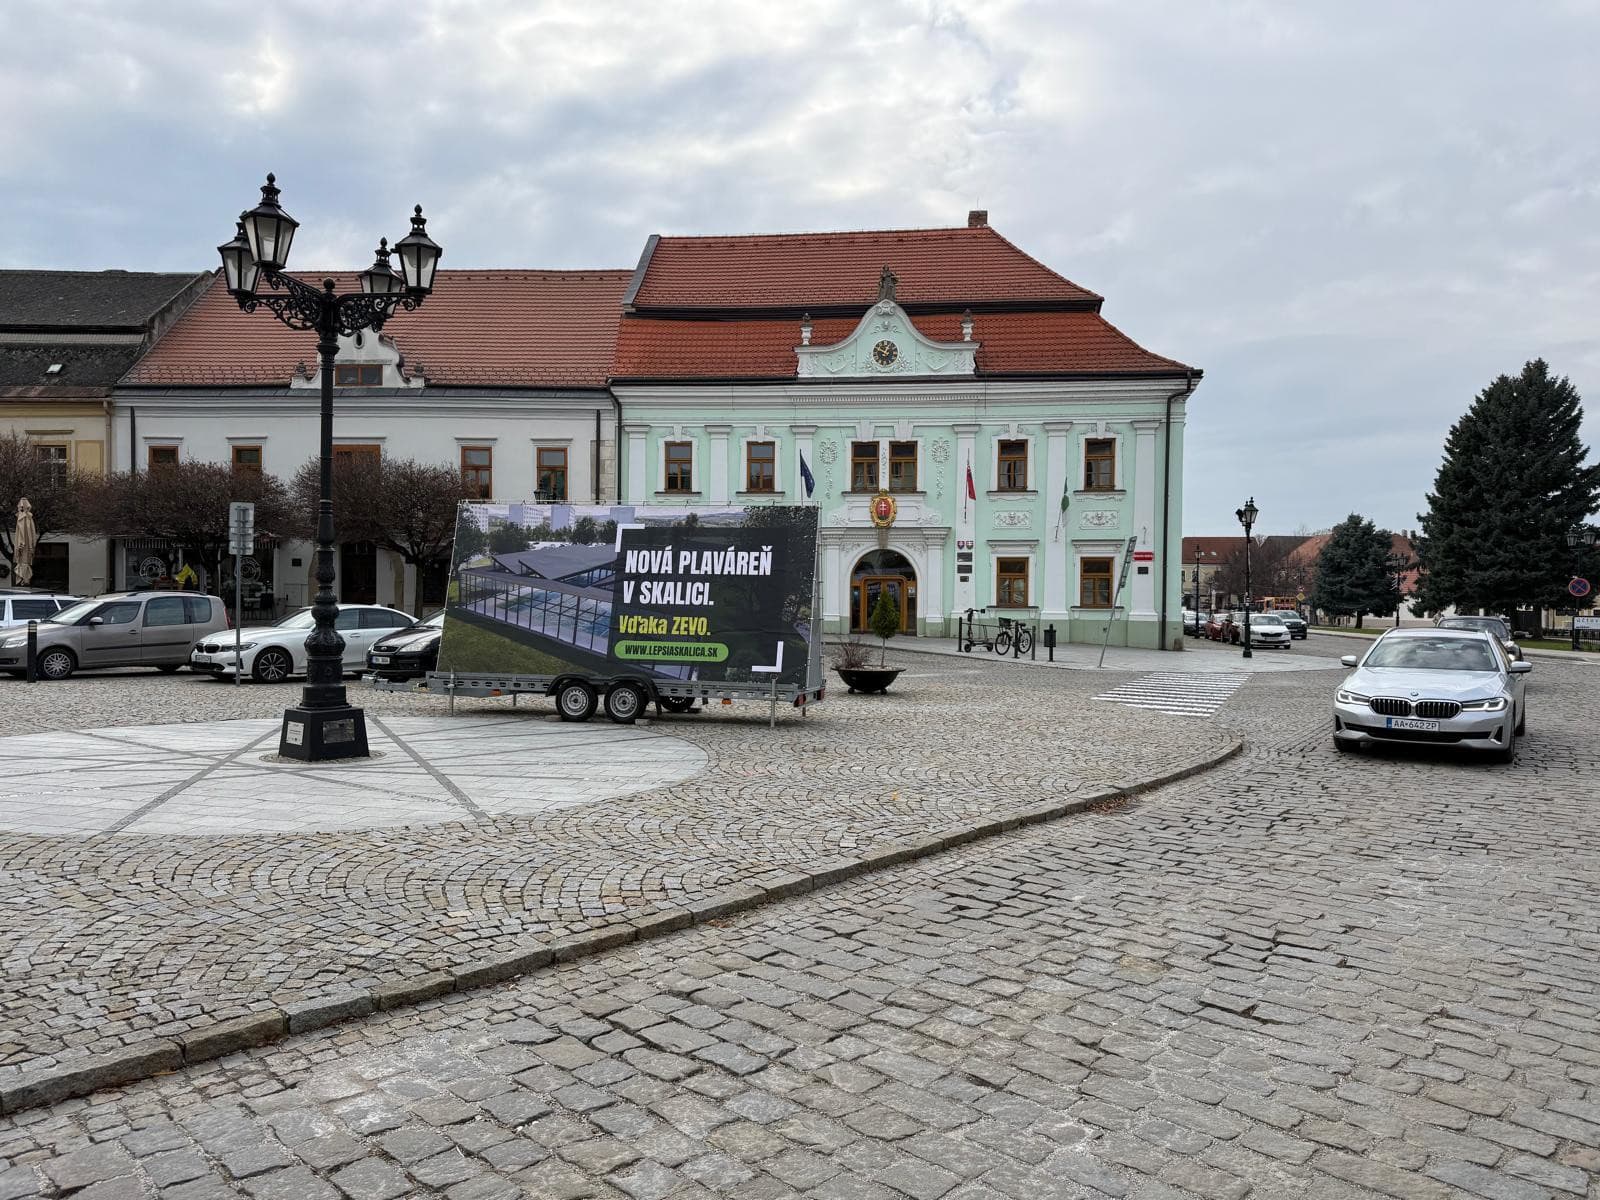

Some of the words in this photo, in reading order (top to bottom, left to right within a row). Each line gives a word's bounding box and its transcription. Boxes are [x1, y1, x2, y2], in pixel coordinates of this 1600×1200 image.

[625, 545, 673, 574] NOVÁ
[678, 545, 773, 576] PLAVÁREŇ
[623, 580, 635, 604] V
[639, 581, 714, 606] SKALICI.
[619, 615, 668, 635] Vďaka
[671, 616, 712, 636] ZEVO.
[625, 644, 718, 657] WWW.LEPSIASKALICA.SK
